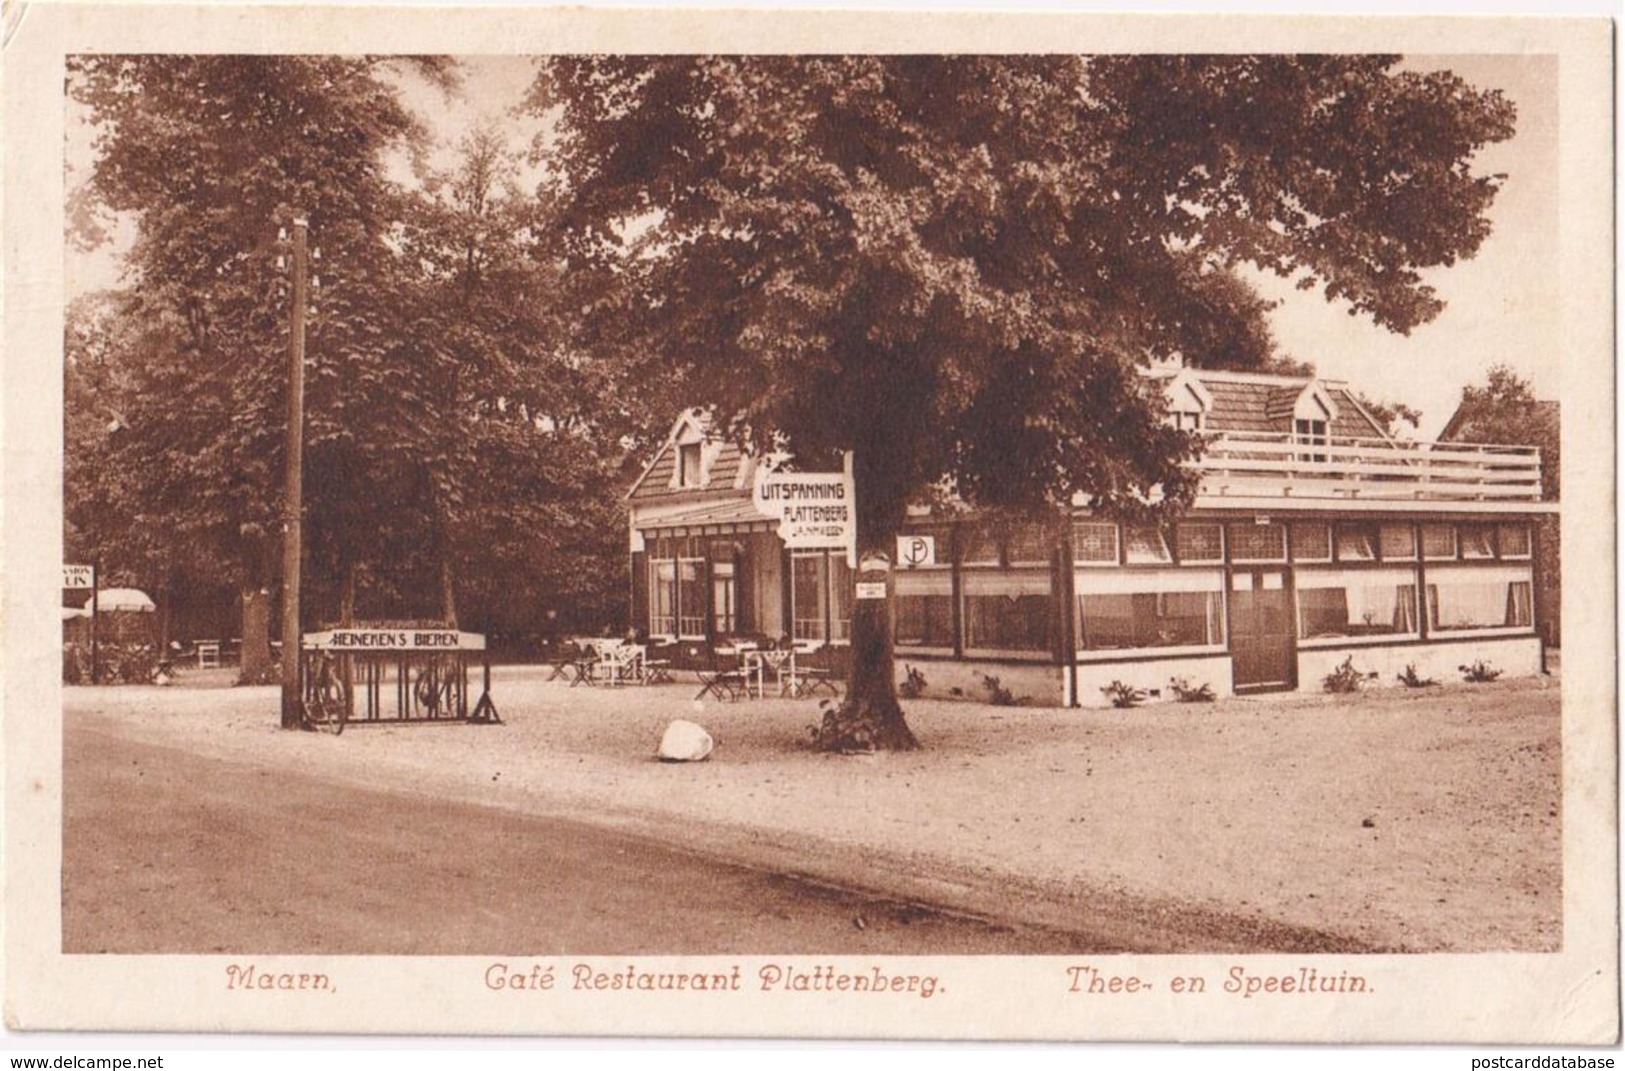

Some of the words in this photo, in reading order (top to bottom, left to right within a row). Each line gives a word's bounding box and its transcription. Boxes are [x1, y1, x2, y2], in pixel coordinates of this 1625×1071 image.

[761, 483, 845, 500] UITSPANNING
[784, 505, 848, 522] PLATTENBERG
[414, 632, 459, 646] BIEREN
